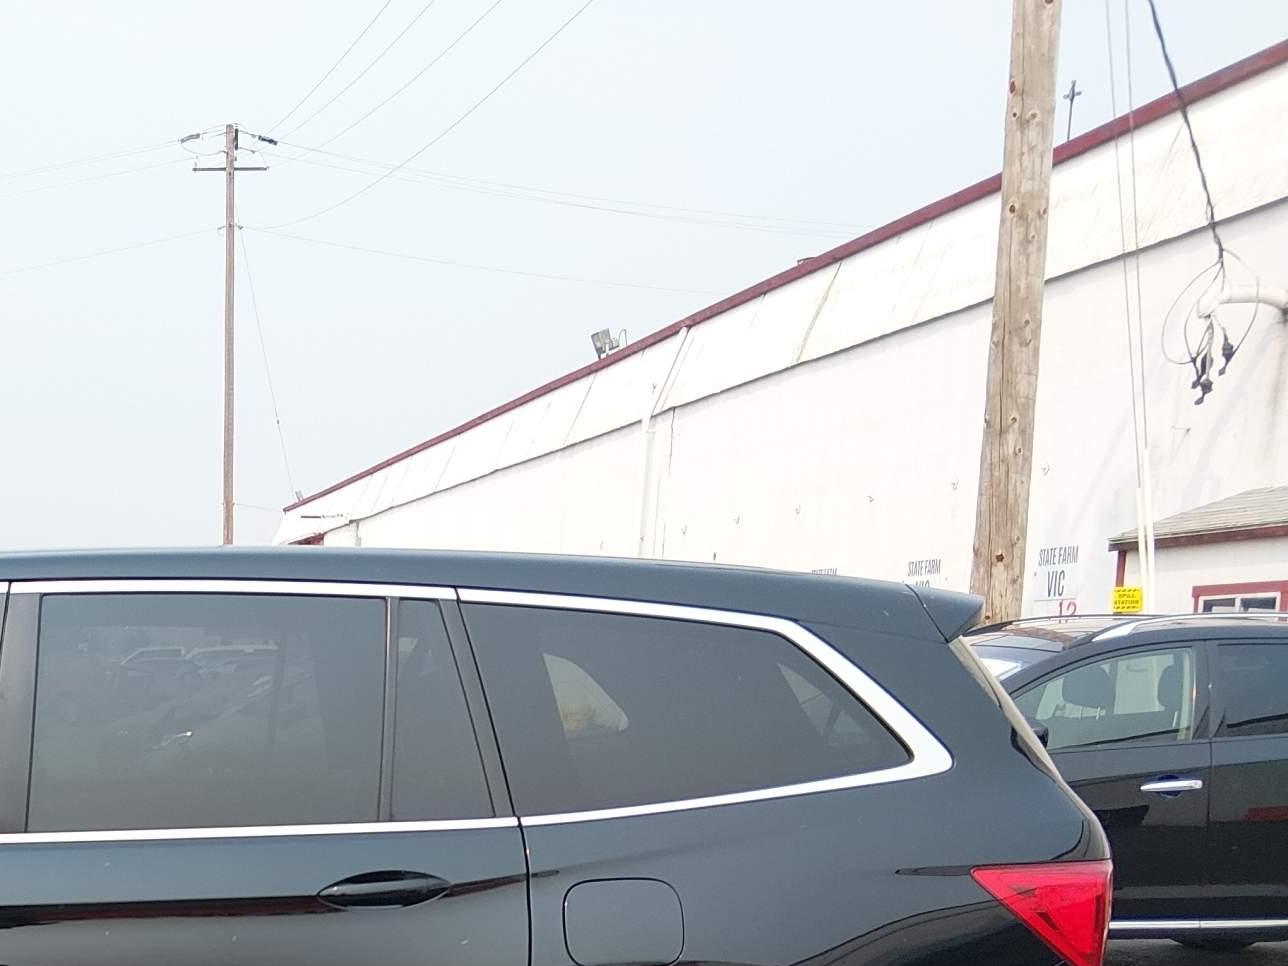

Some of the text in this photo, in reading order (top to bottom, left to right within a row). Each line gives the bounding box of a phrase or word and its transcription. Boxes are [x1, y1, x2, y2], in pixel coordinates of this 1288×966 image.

[1038, 545, 1079, 567] STATE FARM
[907, 558, 941, 577] STATE FARM
[1047, 569, 1065, 598] VIC
